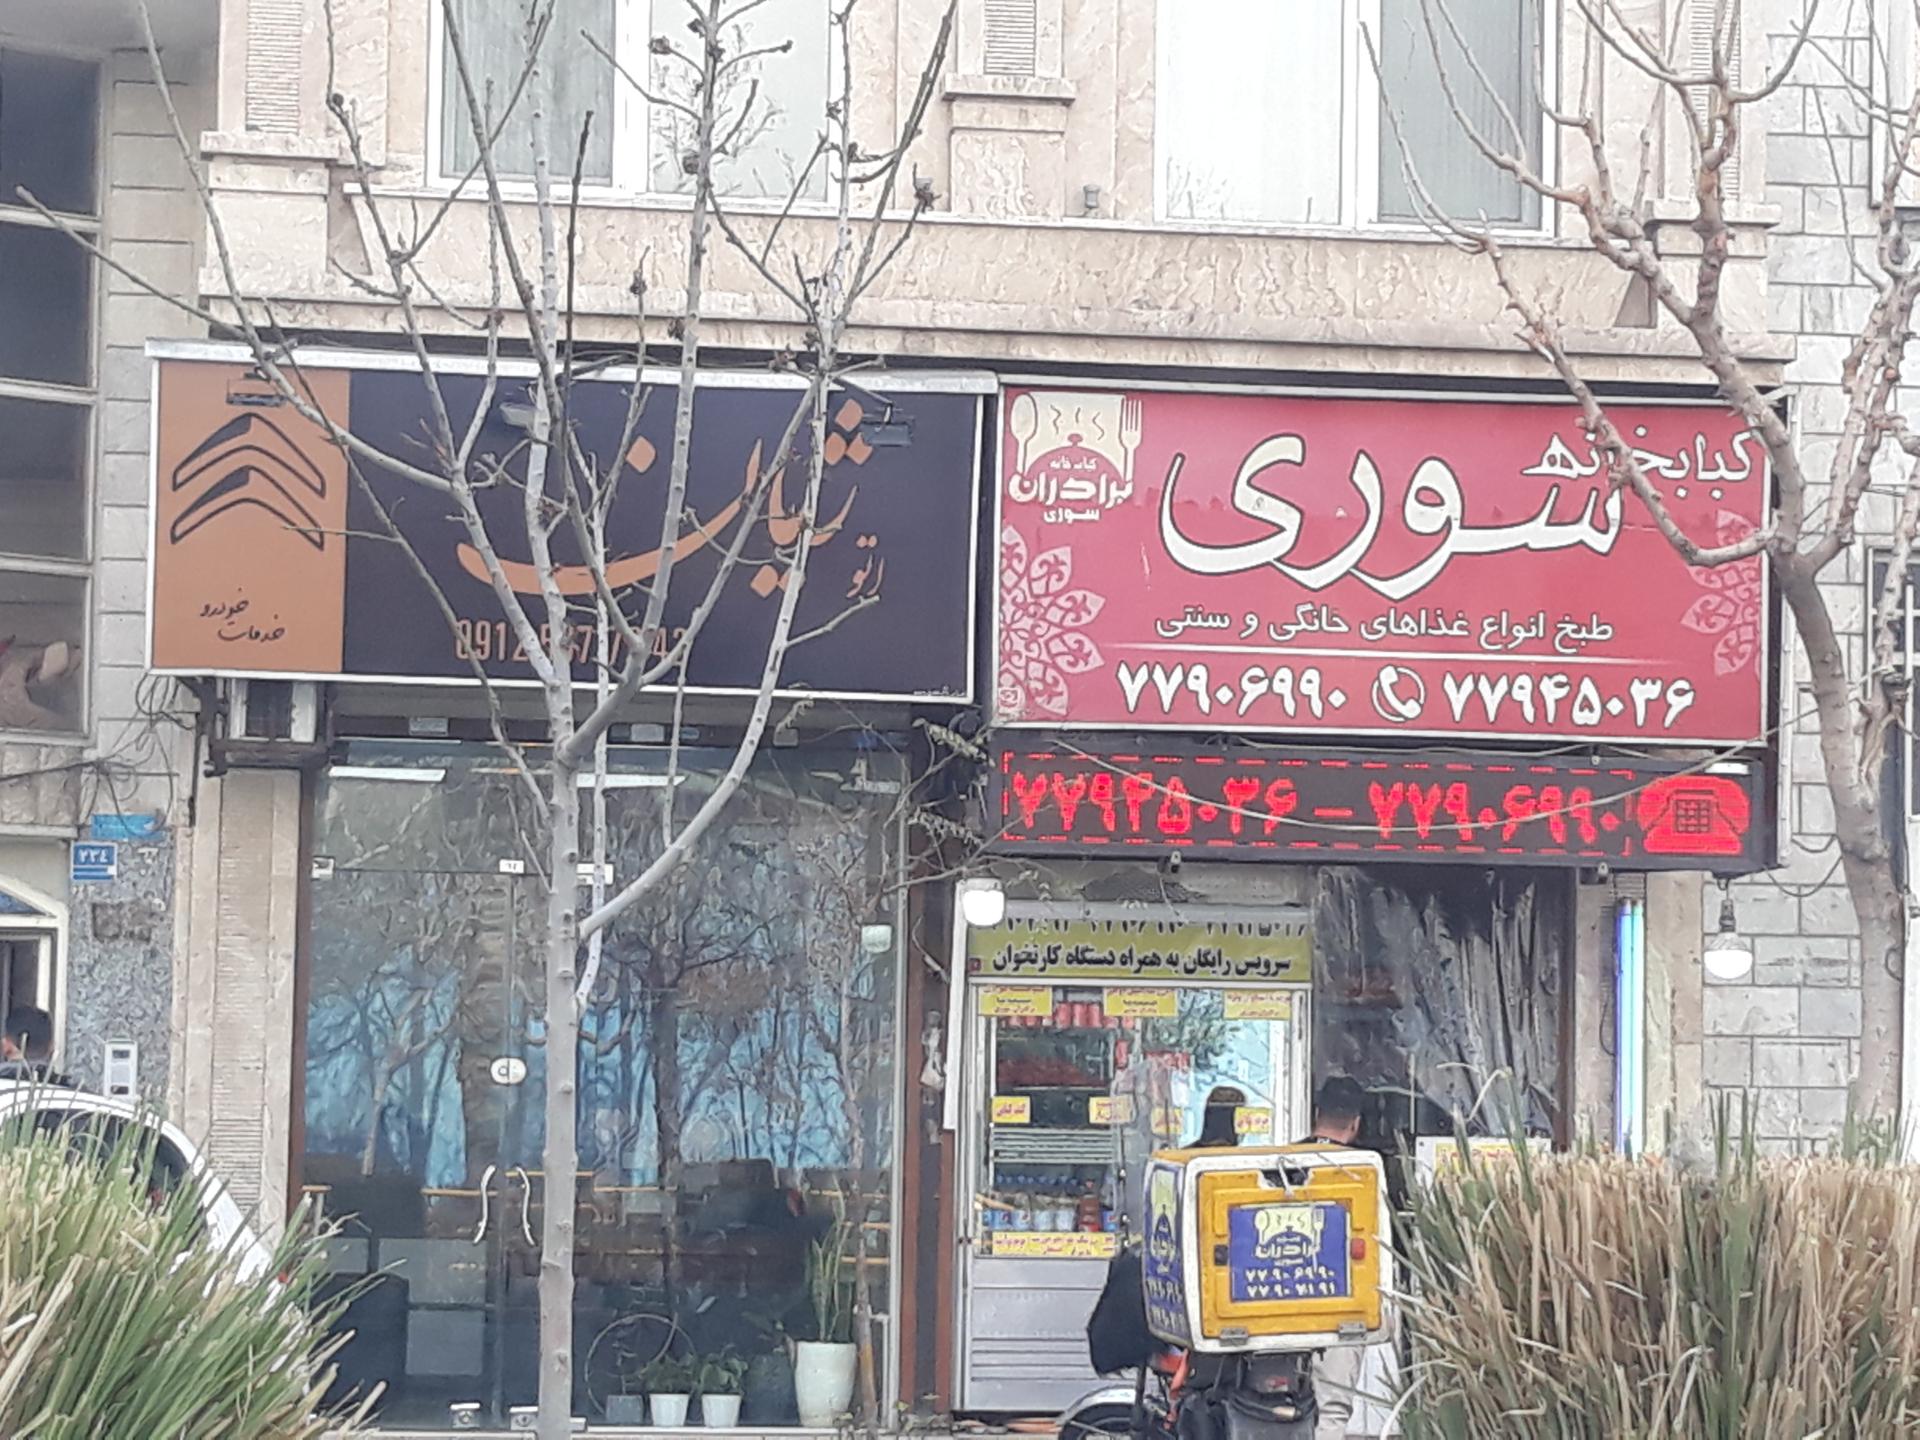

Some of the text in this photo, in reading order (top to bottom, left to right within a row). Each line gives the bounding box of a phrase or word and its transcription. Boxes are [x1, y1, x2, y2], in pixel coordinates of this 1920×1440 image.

[1008, 471, 1134, 509] برادران
[1043, 507, 1101, 524] سوری
[1159, 432, 1623, 600] سوری
[217, 612, 286, 643] خدمات
[1155, 604, 1231, 638] سنتی
[1238, 612, 1260, 639] و
[1359, 606, 1471, 641] غذاهای
[1478, 610, 1546, 651] انواع
[1553, 612, 1614, 654] طبخ
[1116, 659, 1696, 729] ۷۷۹۰۶۹۹۰ ۷۷۹۴۵۰۳۶
[992, 943, 1292, 977] سرویس رایگان به همراه دستگاه کارتخوان
